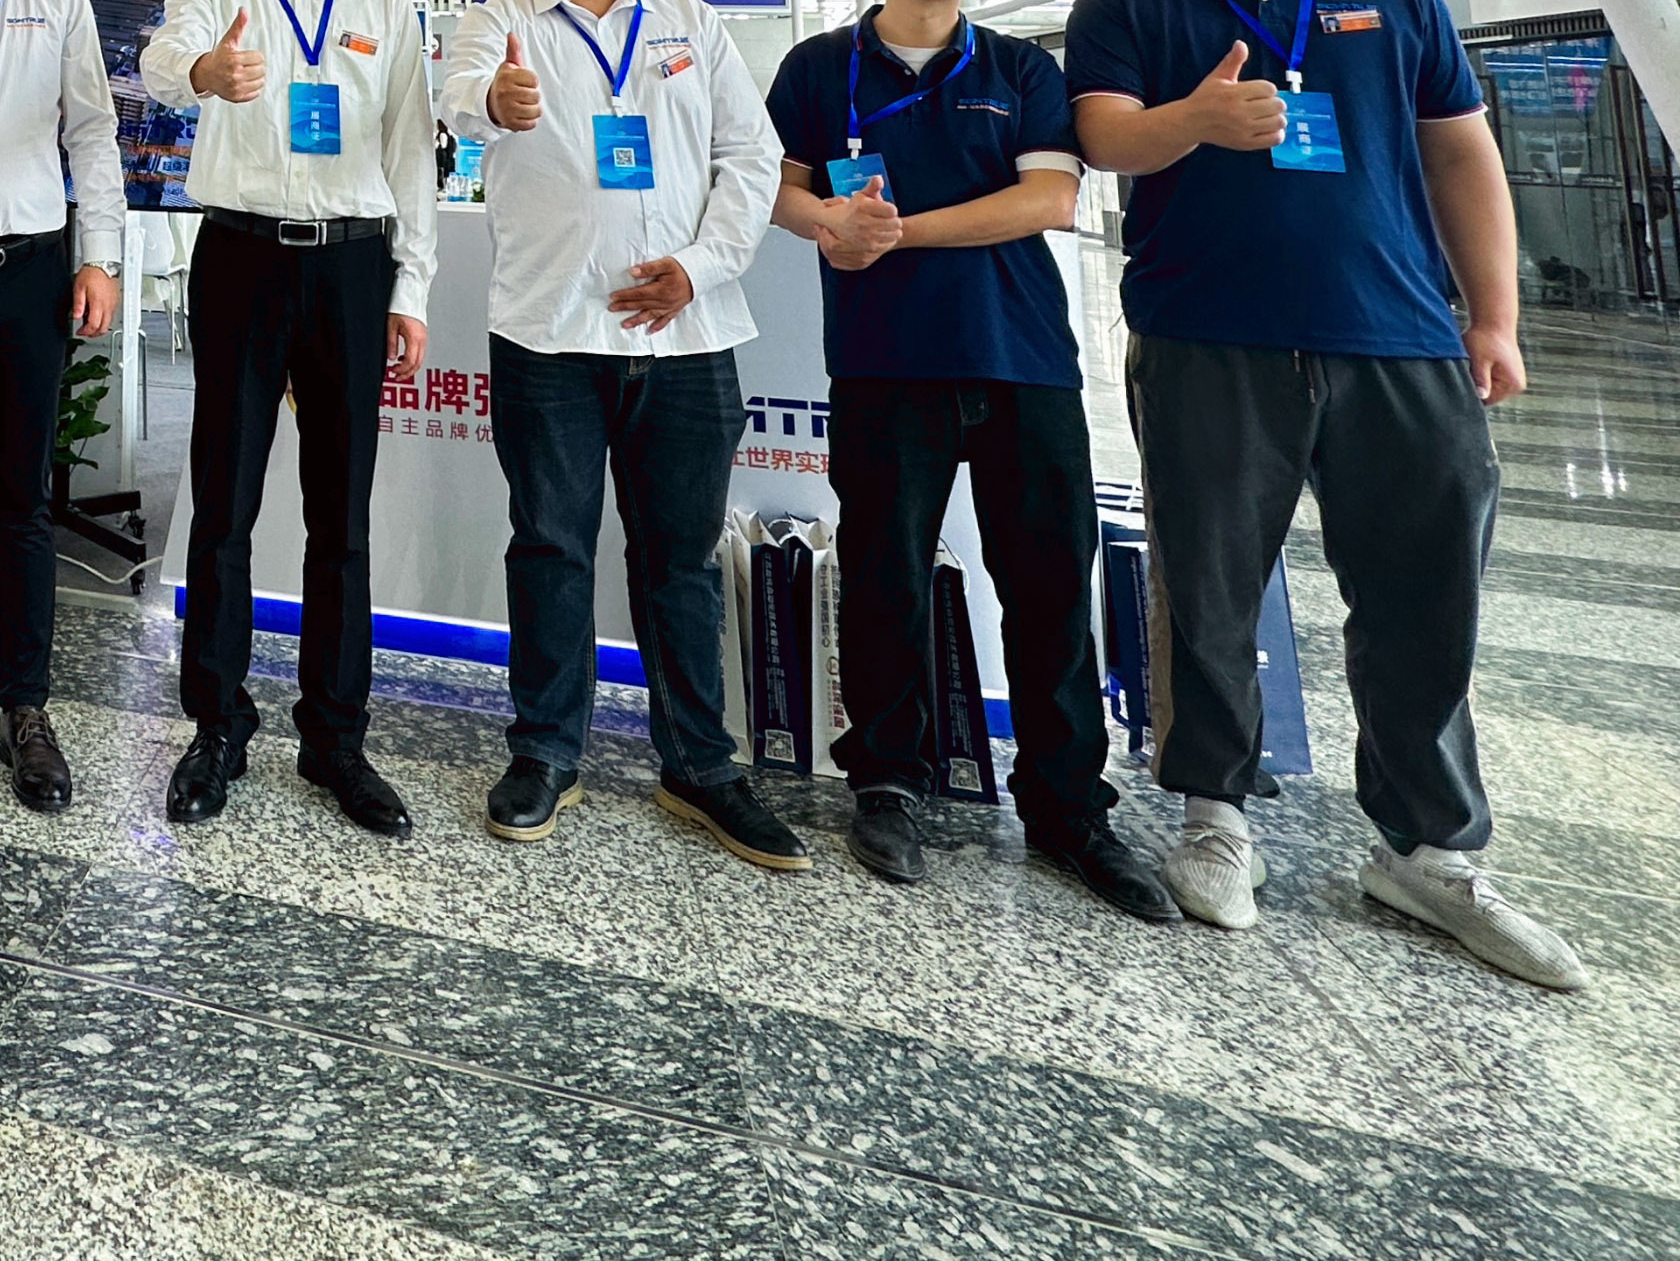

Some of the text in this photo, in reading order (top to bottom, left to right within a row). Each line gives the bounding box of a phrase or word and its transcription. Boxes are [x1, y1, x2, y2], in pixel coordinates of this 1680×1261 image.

[377, 415, 494, 443] 自主品牌优
